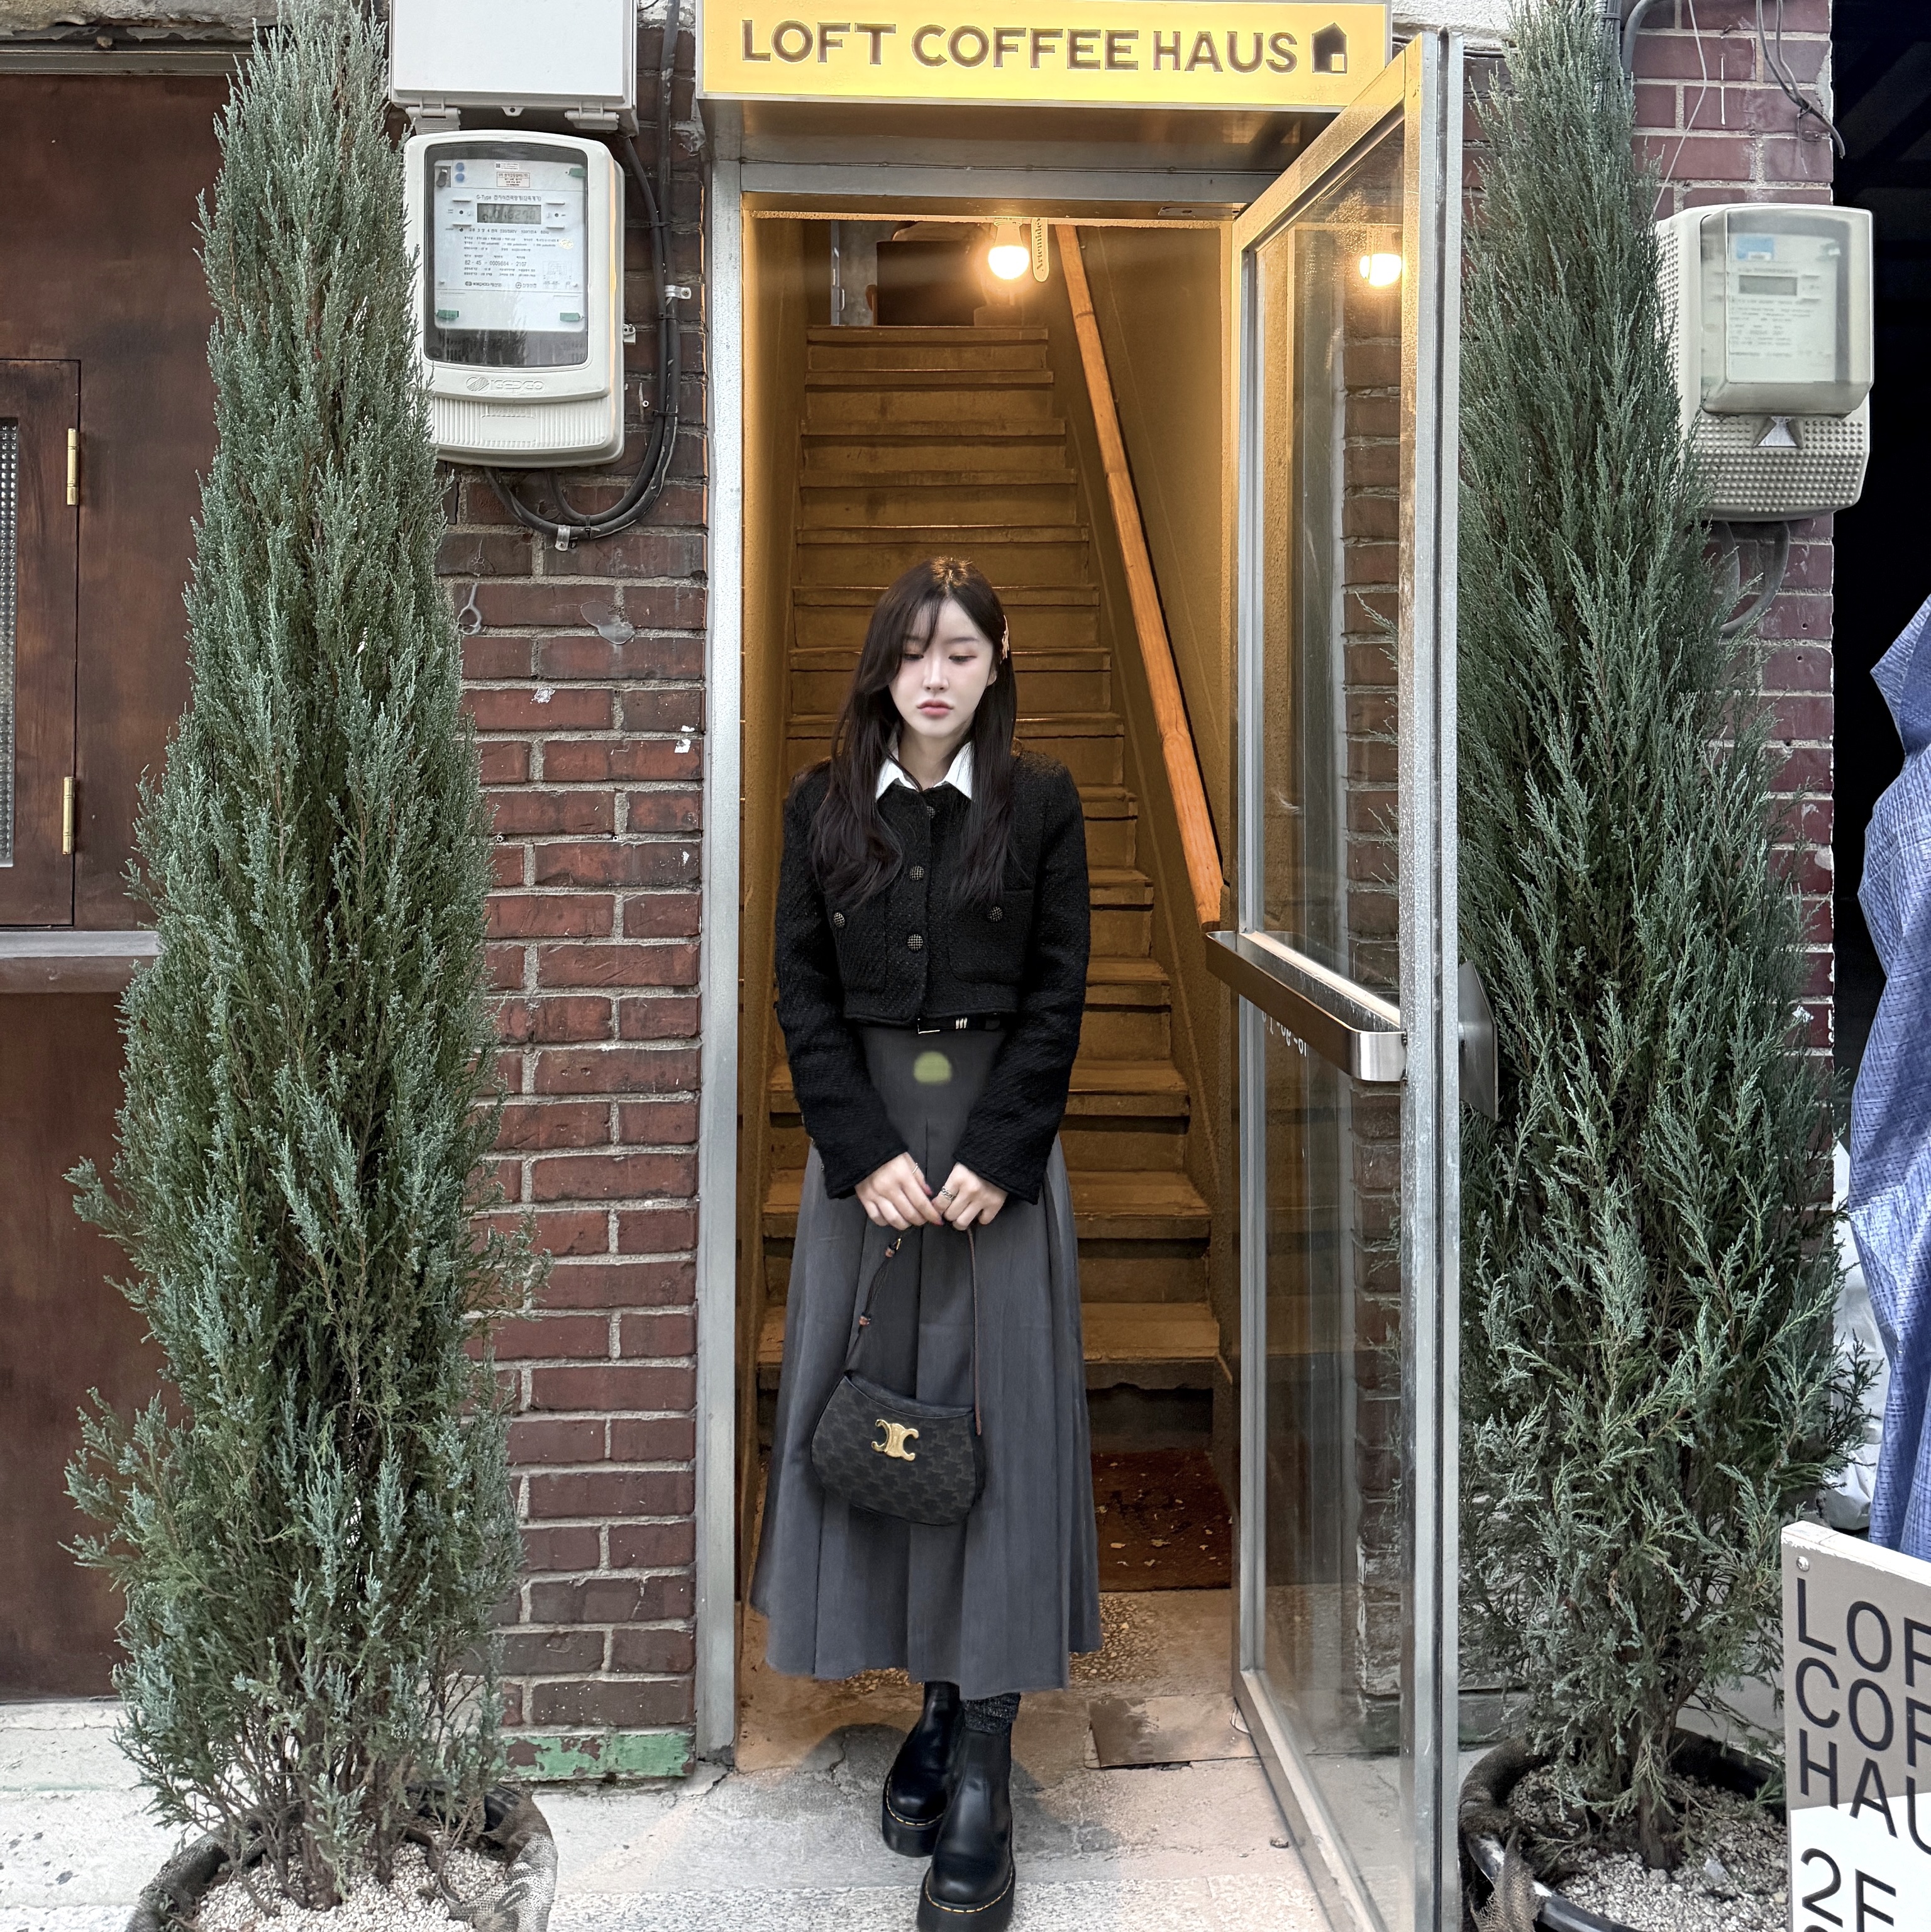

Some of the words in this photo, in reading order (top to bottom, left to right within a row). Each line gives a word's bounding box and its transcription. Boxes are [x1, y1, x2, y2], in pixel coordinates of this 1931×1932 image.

[742, 19, 896, 65] LOFT
[910, 24, 1139, 70] COFFEE
[1153, 31, 1298, 73] HAUS
[1797, 1577, 1931, 1687] LOF
[1796, 1657, 1931, 1768] COF
[1800, 1848, 1896, 1932] 2F
